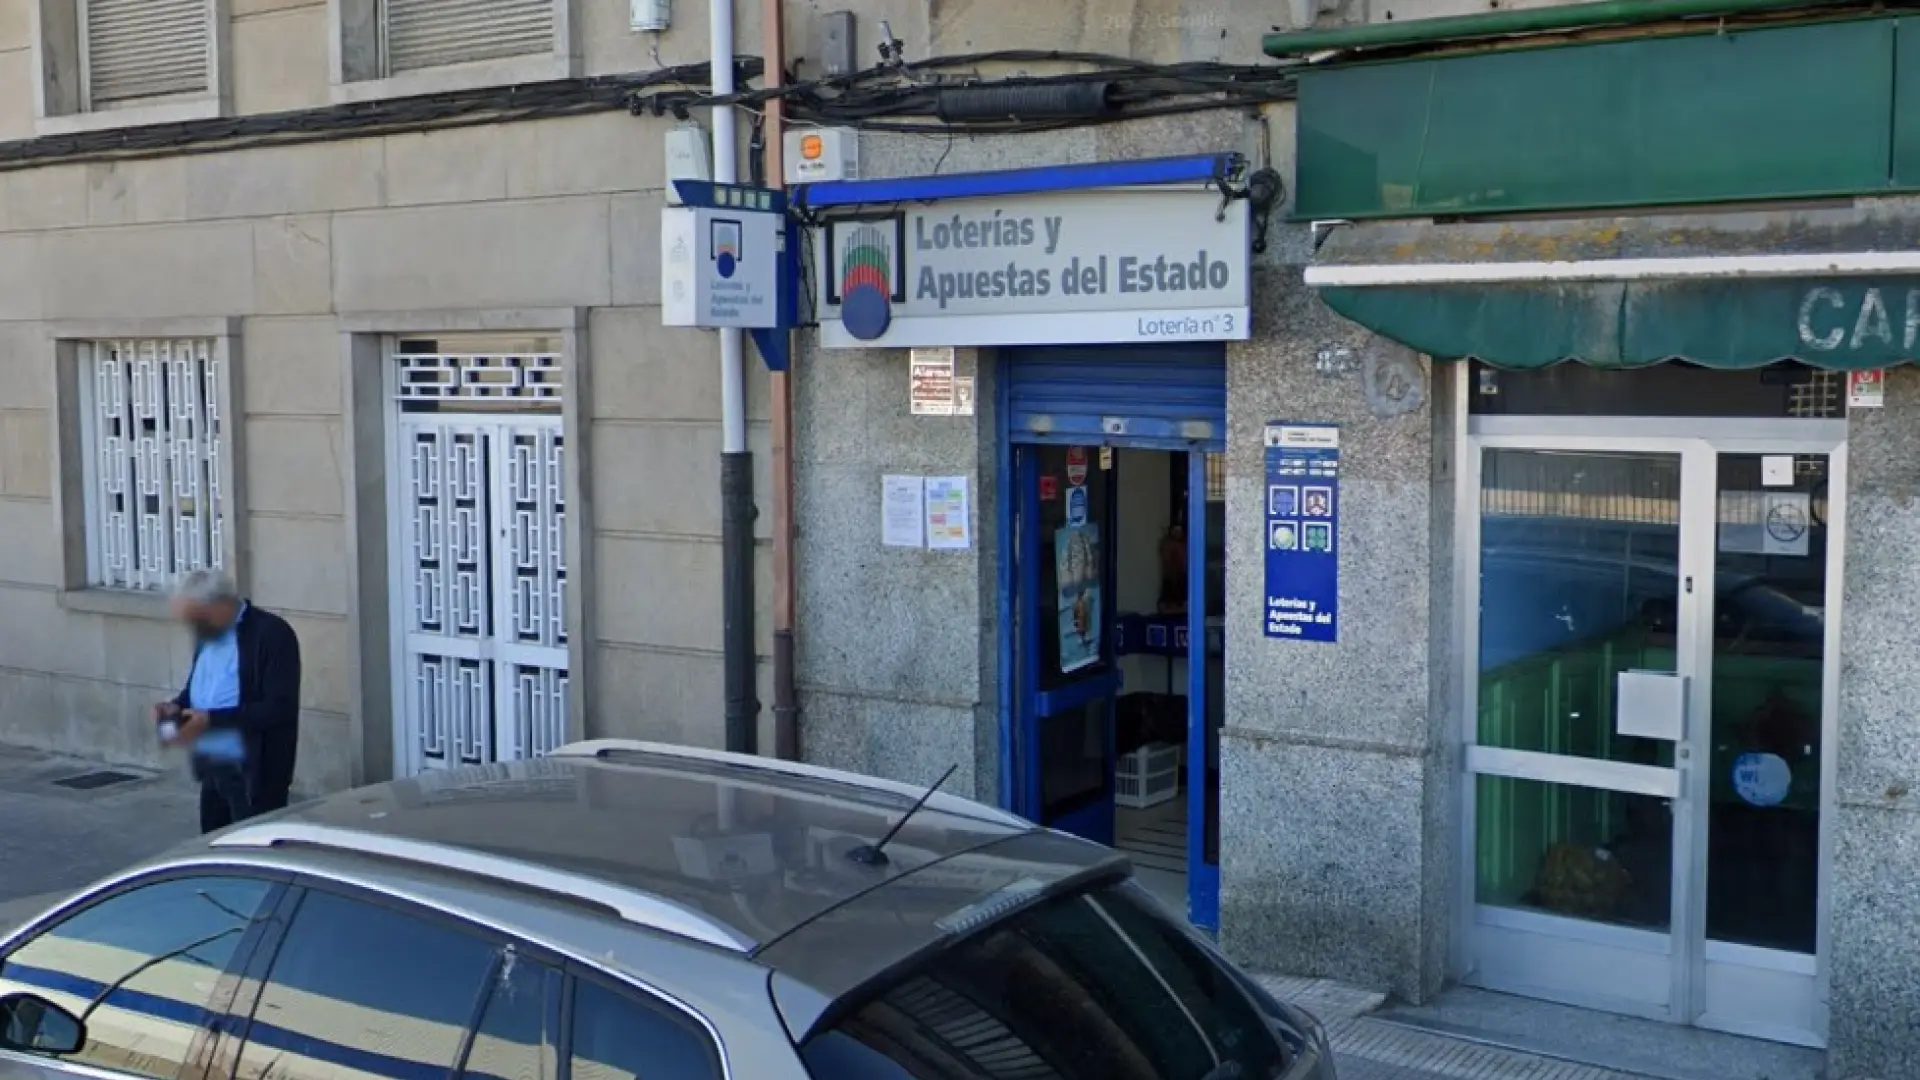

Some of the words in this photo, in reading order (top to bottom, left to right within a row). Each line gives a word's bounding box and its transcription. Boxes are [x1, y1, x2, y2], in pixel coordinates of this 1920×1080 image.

[917, 209, 1034, 249] Loterías
[1044, 216, 1062, 254] y
[917, 261, 1050, 309] Apuestas
[1062, 255, 1107, 295] del
[1119, 249, 1229, 293] Estado
[1138, 317, 1198, 336] Lotería
[1223, 314, 1234, 332] 3
